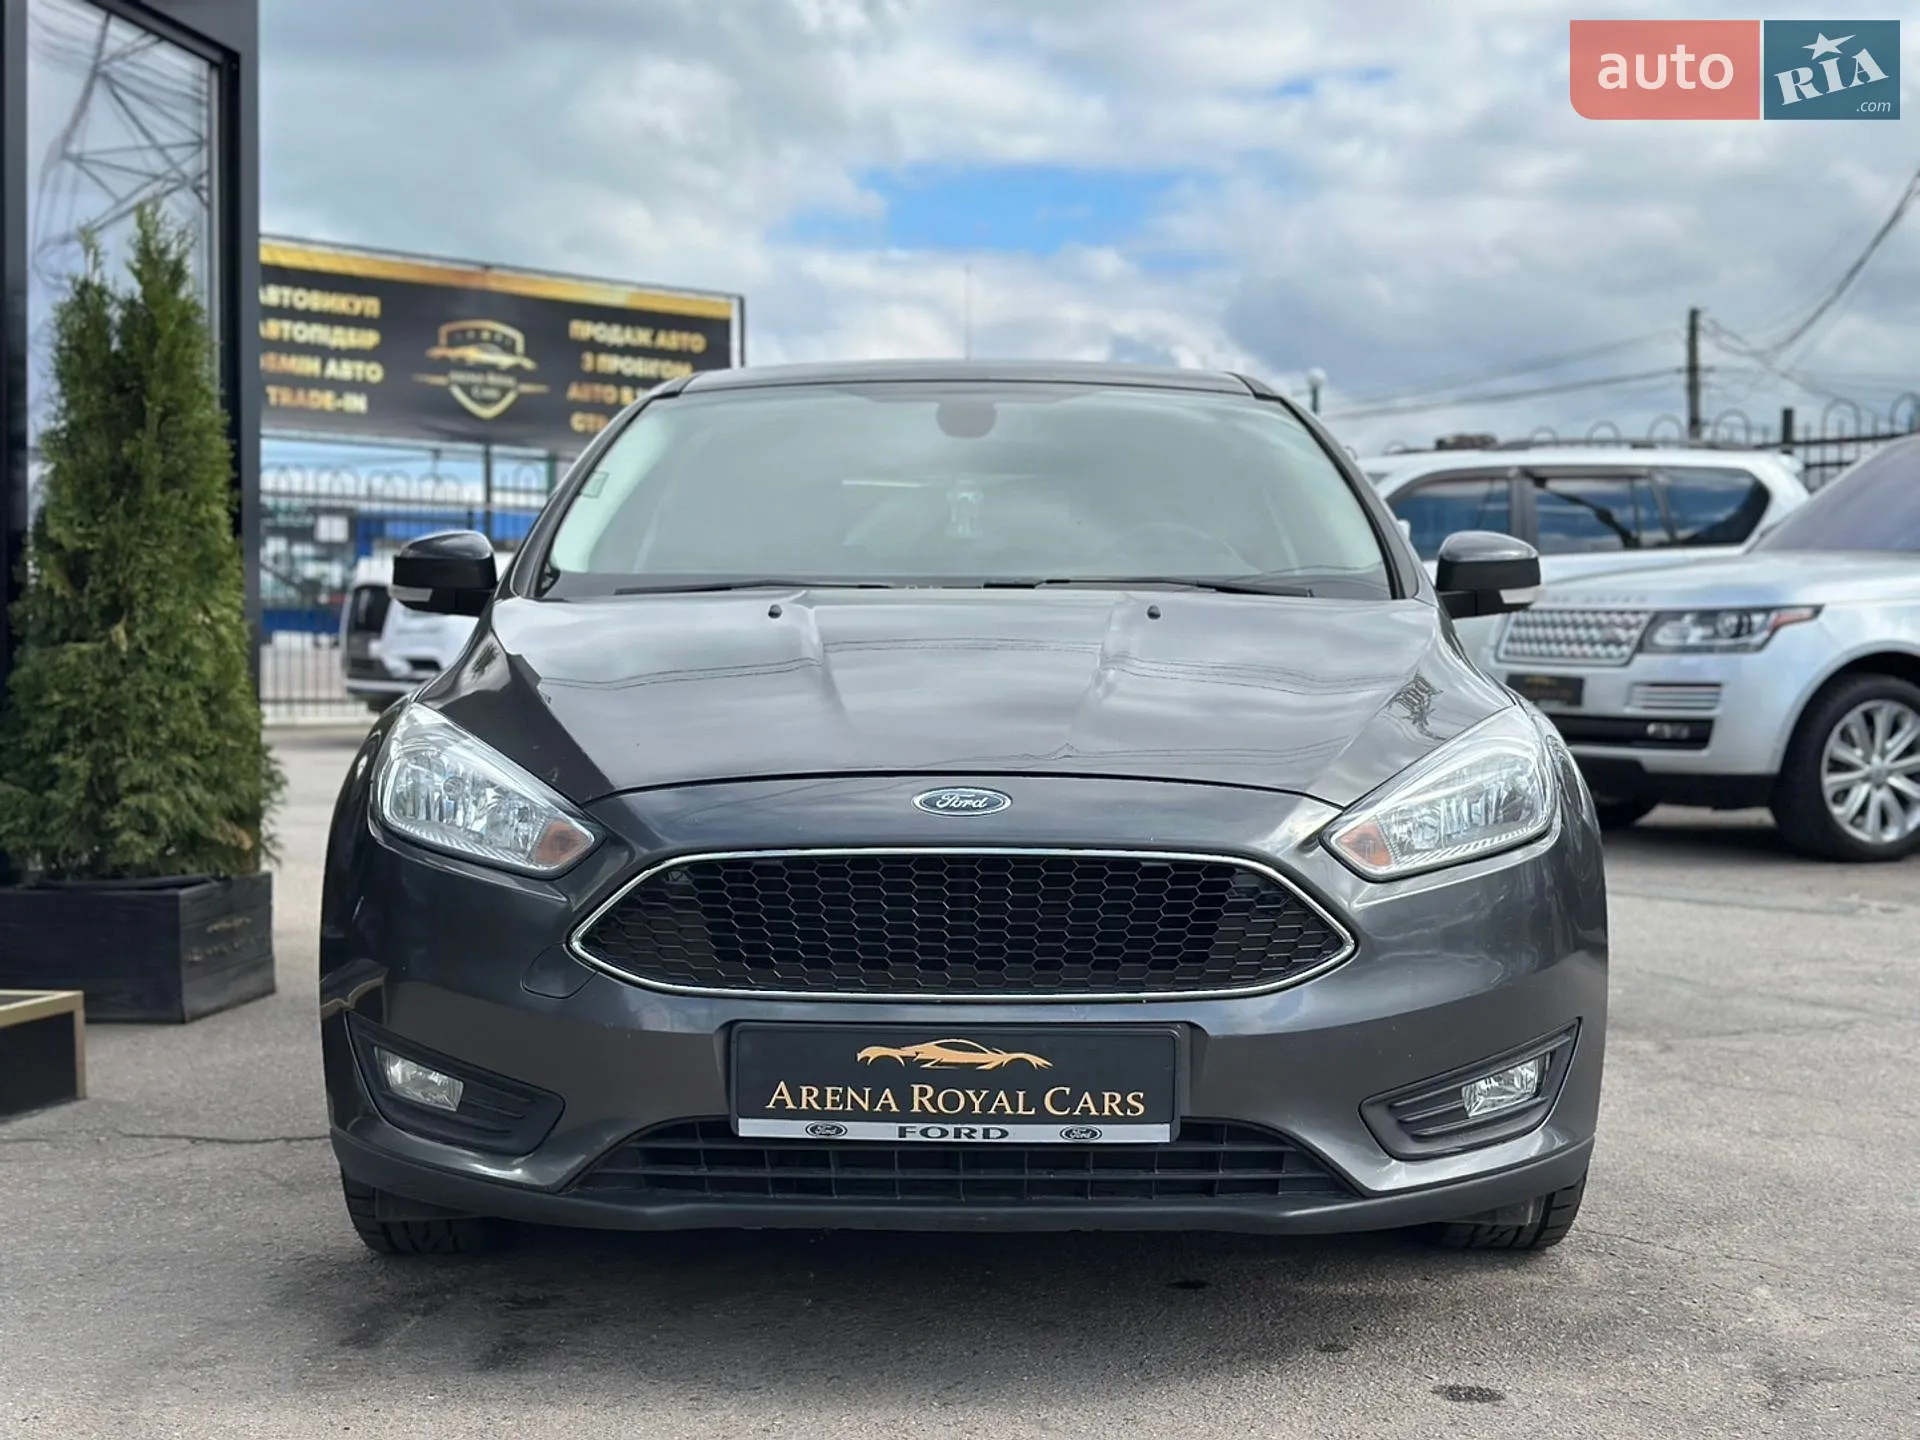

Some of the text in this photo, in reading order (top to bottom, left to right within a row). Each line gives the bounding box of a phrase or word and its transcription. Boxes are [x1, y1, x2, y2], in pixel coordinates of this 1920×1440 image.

[569, 319, 707, 353] ПРОДАЖ АВТО
[324, 357, 384, 384] АВТО
[265, 385, 368, 414] TRADE-IN
[567, 381, 618, 410] АВТО
[935, 793, 988, 809] Ford
[766, 1080, 1145, 1117] ARENA ROYAL CARS
[898, 1125, 1010, 1140] FORD
